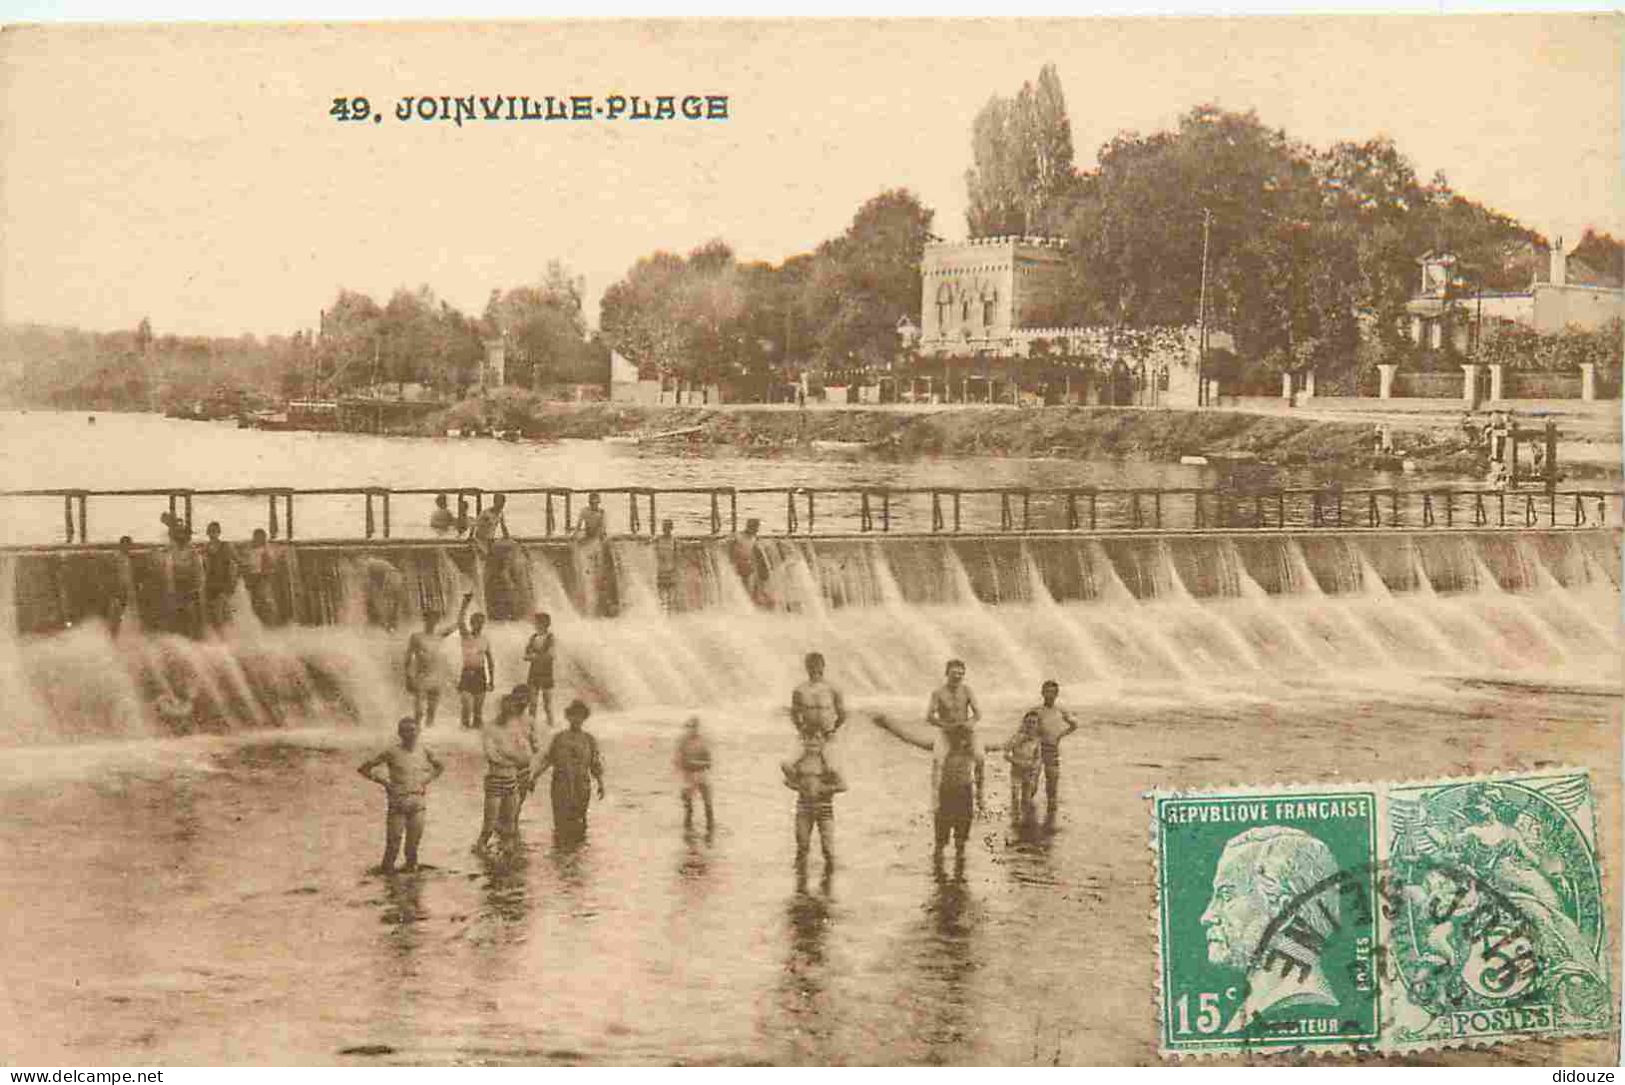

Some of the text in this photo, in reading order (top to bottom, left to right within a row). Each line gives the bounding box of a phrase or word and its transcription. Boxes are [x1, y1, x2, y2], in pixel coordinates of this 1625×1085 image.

[329, 96, 383, 123] 49.
[1275, 801, 1367, 820] FRANÇAISE
[1267, 1018, 1339, 1034] TEUR
[1453, 1007, 1550, 1035] POSTES
